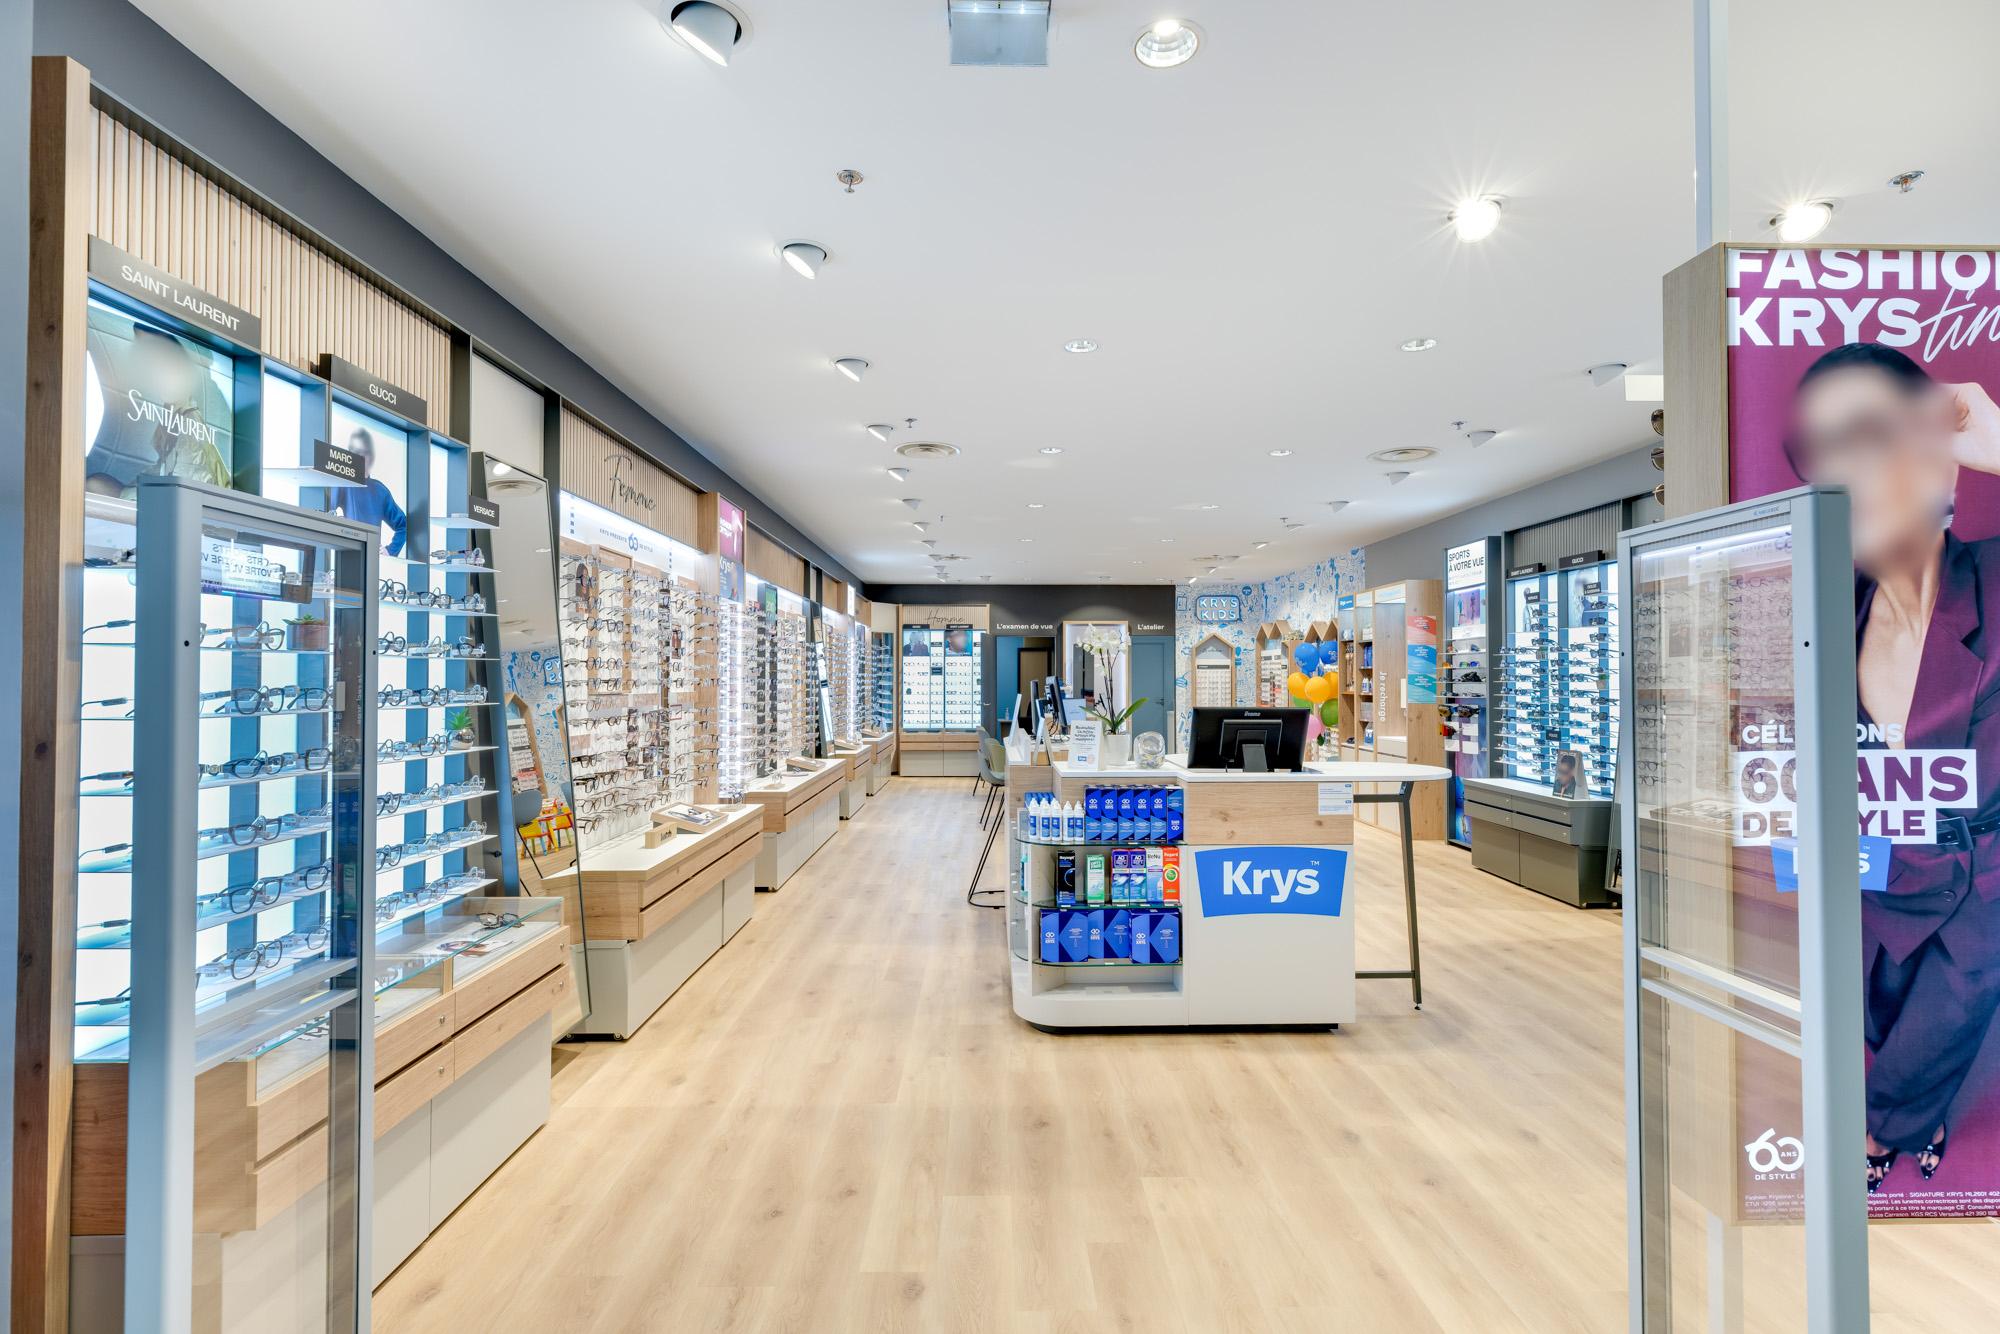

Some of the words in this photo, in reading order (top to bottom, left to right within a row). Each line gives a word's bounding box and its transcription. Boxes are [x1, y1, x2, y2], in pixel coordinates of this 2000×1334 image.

[1727, 249, 2000, 290] FASHIO
[121, 265, 170, 299] SAINT
[174, 289, 240, 332] LAURENT
[369, 383, 397, 406] GUCCI
[329, 448, 353, 465] MARC
[325, 461, 356, 478] JACOBS
[604, 454, 656, 512] Femme
[473, 504, 496, 519] VERSACE
[1449, 549, 1471, 562] SPORTS
[1454, 559, 1472, 571] VOTRE
[1473, 556, 1485, 567] VUE
[1520, 567, 1534, 575] LAURENT
[1200, 598, 1239, 609] KRYS
[925, 608, 966, 625] Homme
[1201, 610, 1237, 619] KIDS
[997, 623, 1029, 631] L'examen
[1378, 682, 1388, 722] recharge
[1742, 720, 1904, 745] CÉLONS
[1742, 811, 1793, 838] DE
[1223, 861, 1320, 904] Krys
[1745, 1128, 1805, 1173] 60
[1755, 1173, 1767, 1181] DE
